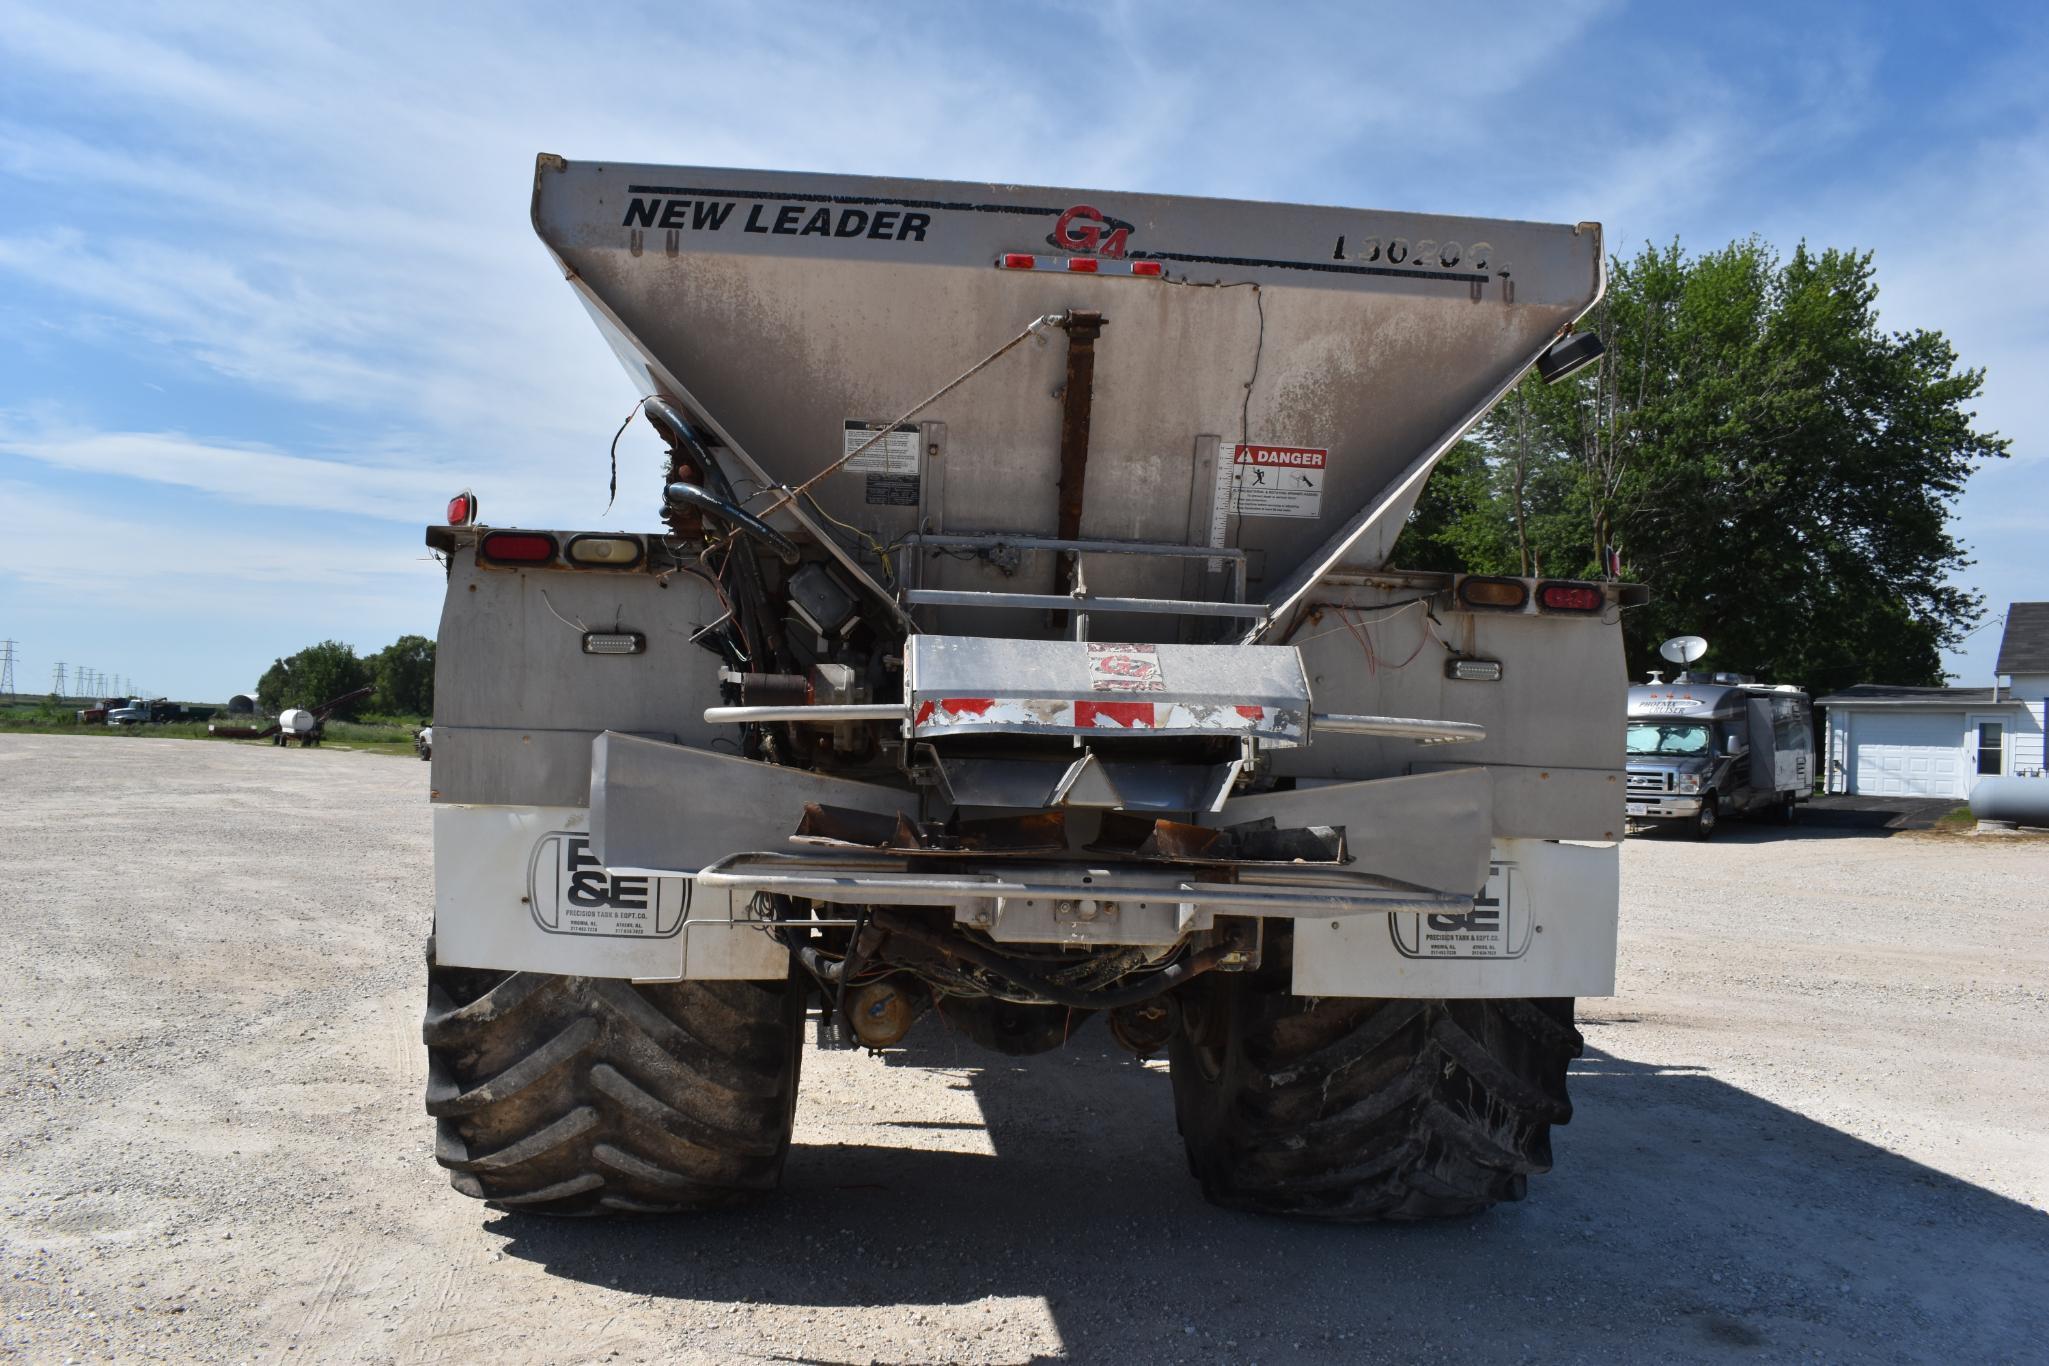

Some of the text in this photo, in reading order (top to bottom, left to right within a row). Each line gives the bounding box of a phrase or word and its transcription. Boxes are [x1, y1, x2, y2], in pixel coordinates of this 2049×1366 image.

[622, 198, 932, 242] NEW LEADER
[1055, 204, 1129, 260] G4
[1257, 450, 1323, 466] DANGER
